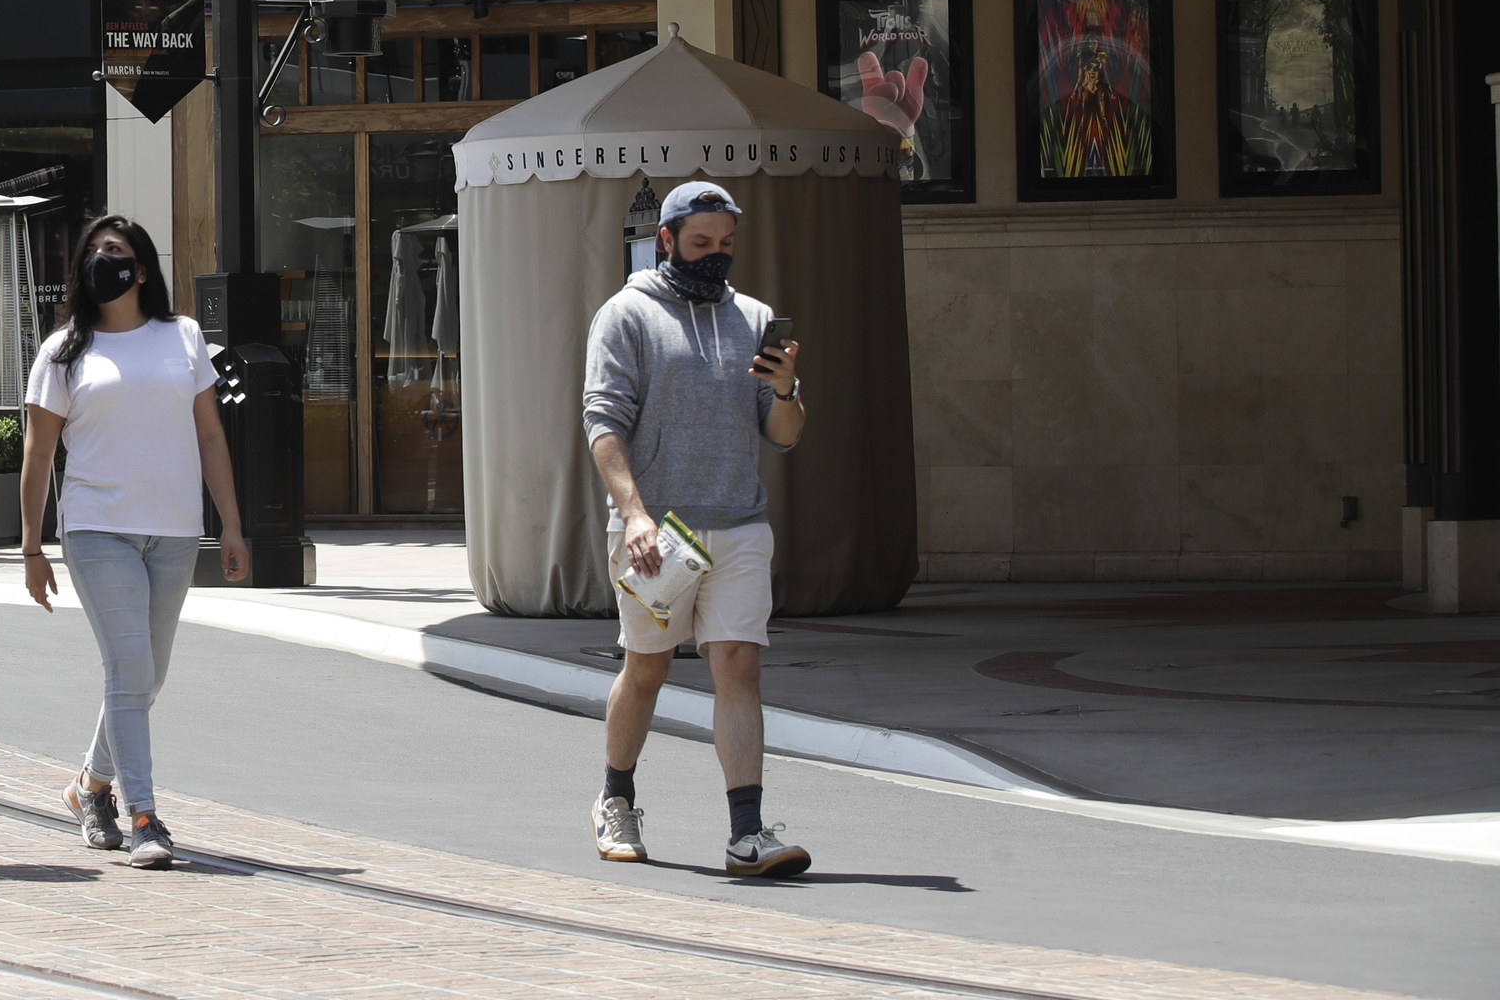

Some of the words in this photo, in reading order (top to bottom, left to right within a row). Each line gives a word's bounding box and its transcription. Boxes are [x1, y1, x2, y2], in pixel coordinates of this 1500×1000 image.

[106, 22, 119, 30] BEN
[121, 22, 149, 31] AFFLECK
[106, 32, 130, 48] THE
[132, 32, 159, 48] WAY
[162, 33, 194, 48] BACK
[859, 27, 897, 48] WORLD
[898, 25, 933, 47] TOUR
[107, 65, 135, 75] MARCH
[136, 65, 142, 75] 6
[507, 145, 670, 171] SINCERELY
[703, 144, 798, 164] YOURS
[823, 145, 861, 164] USA
